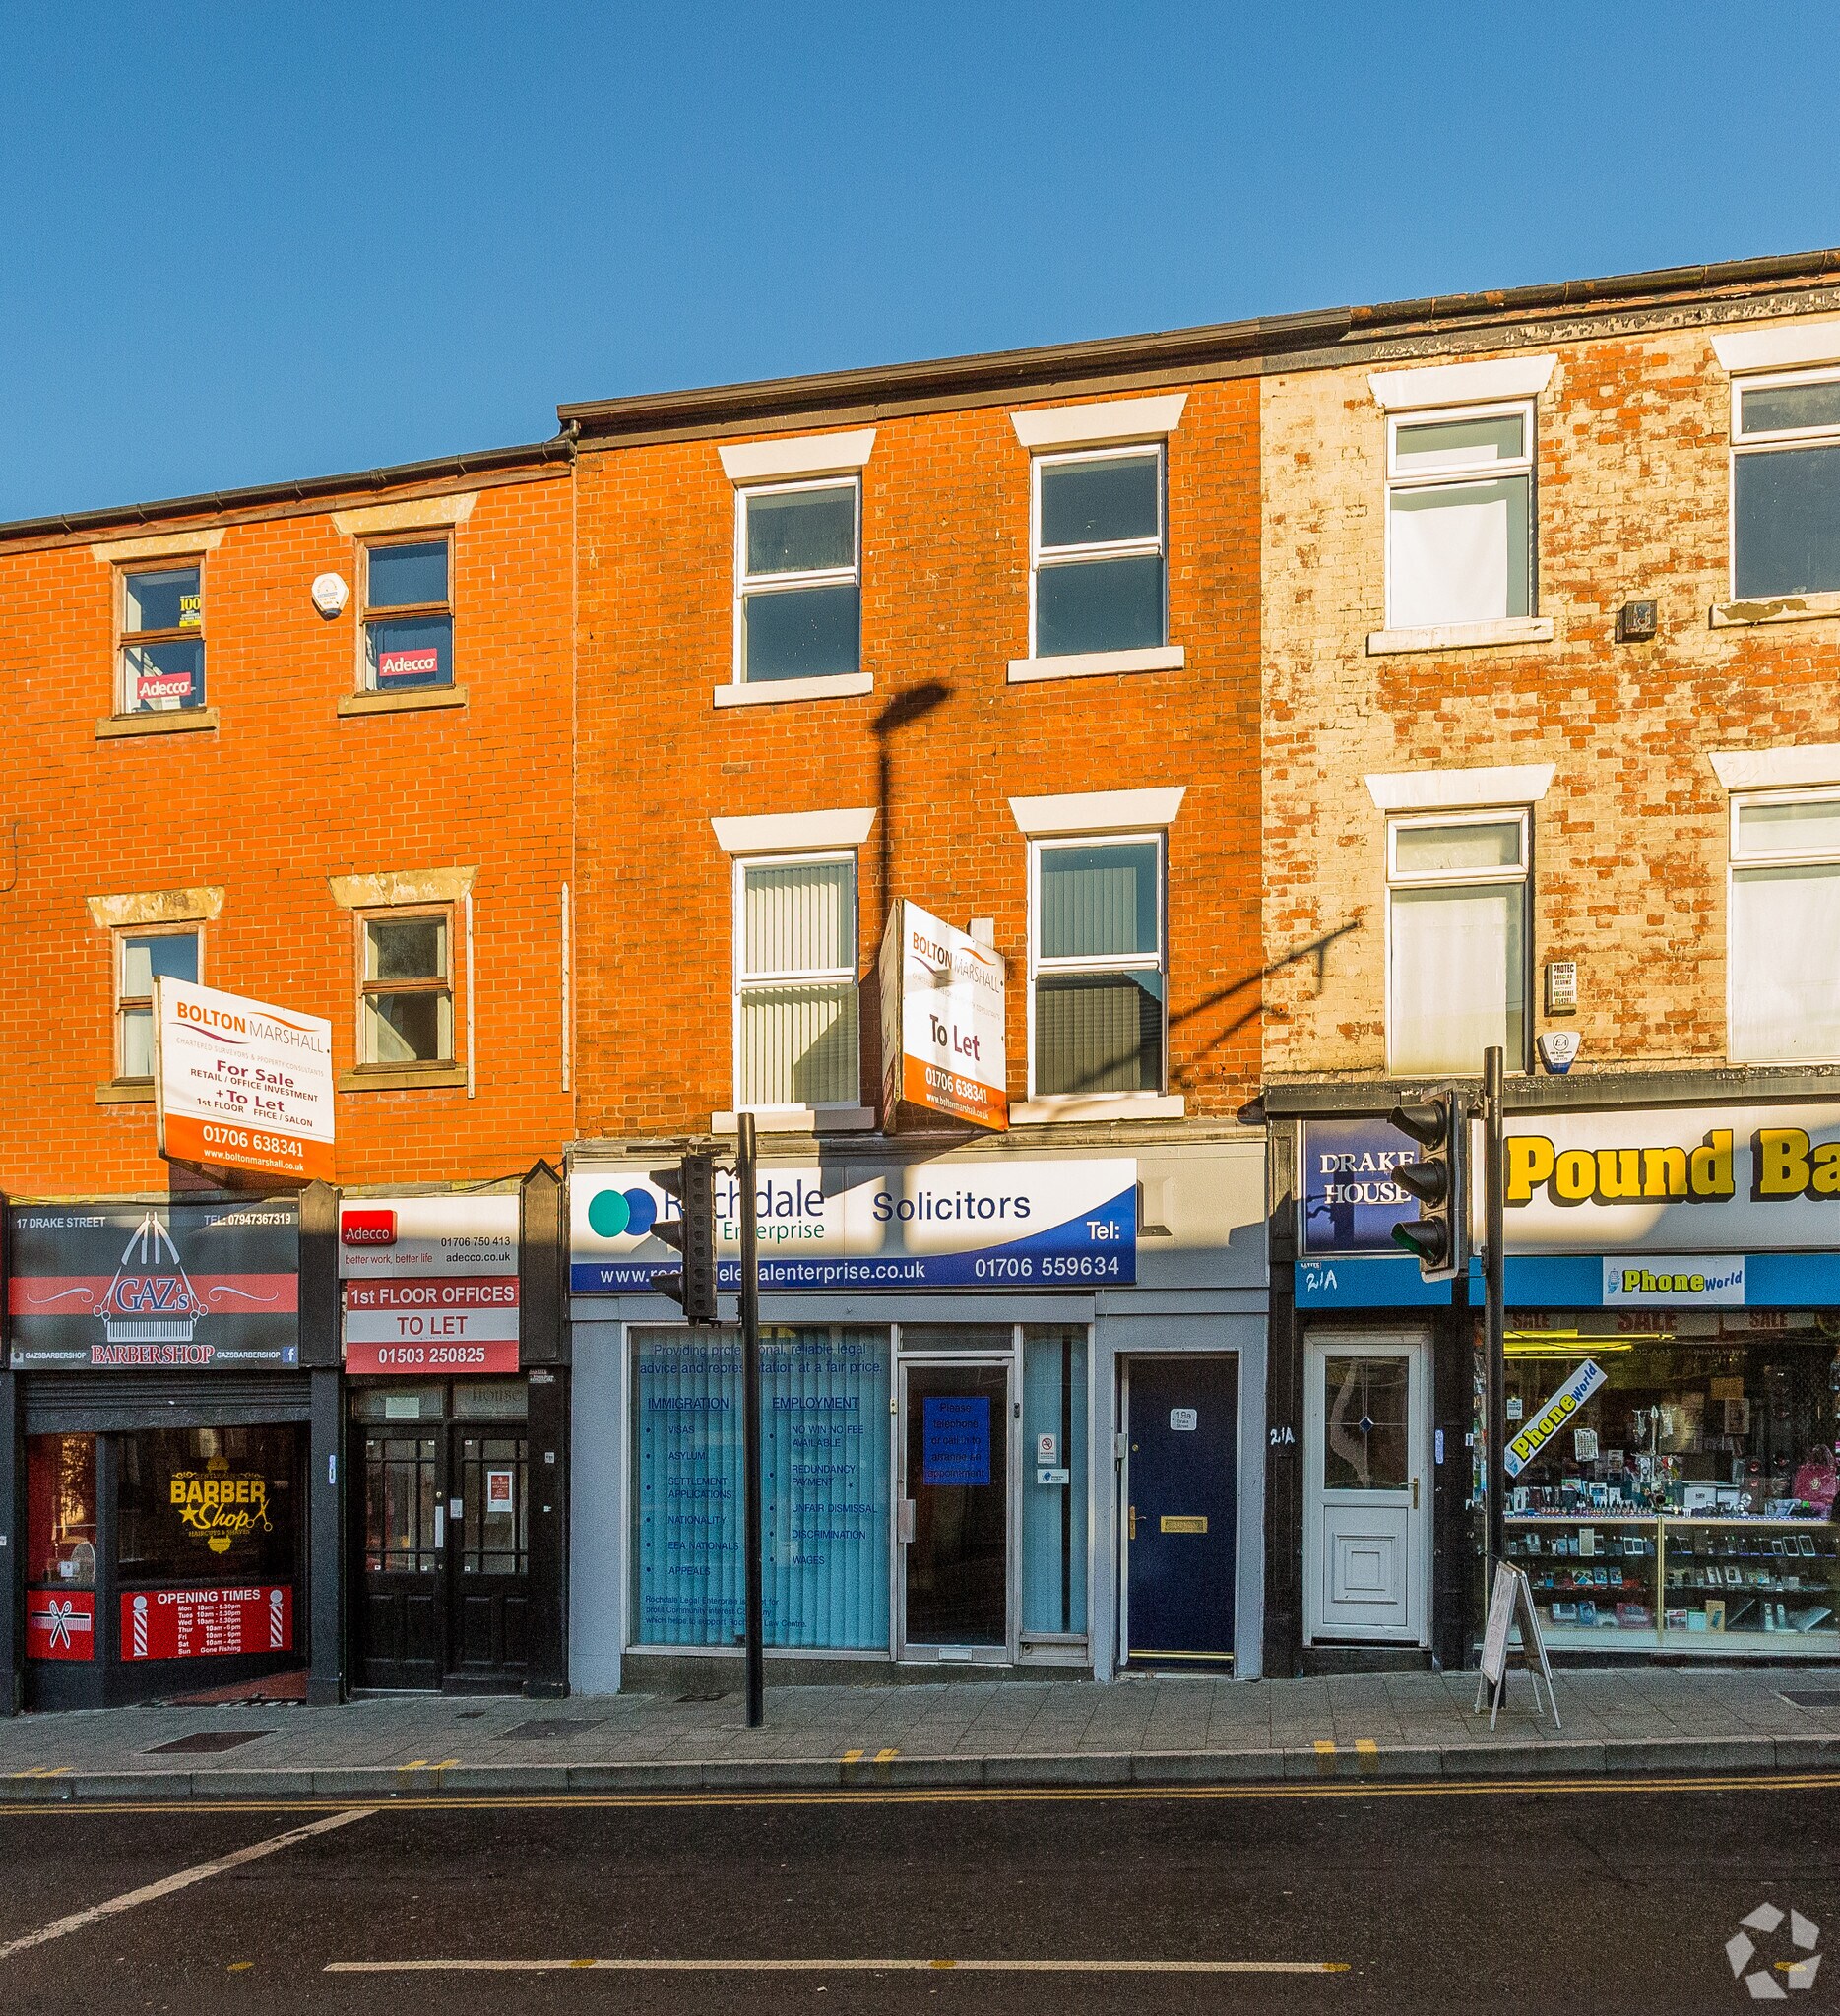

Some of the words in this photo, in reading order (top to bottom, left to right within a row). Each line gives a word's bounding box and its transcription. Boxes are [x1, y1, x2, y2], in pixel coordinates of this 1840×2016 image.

[180, 598, 201, 611] 100
[383, 657, 436, 673] Adecco
[140, 681, 189, 697] Adecco
[913, 932, 953, 969] BOLTON
[954, 955, 1000, 994] MARSHALL
[176, 1001, 246, 1034] BOLTON
[249, 1020, 323, 1053] MARSHALL
[929, 1014, 948, 1047] To
[953, 1024, 981, 1061] Let
[176, 1037, 213, 1051] CHARTERED
[215, 1045, 249, 1060] SURVEYORS
[257, 1054, 286, 1069] PROPERTY
[286, 1062, 324, 1077] CONSULTANTS
[217, 1059, 249, 1078] For
[256, 1068, 294, 1088] Sale
[190, 1068, 222, 1083] RETAIL
[230, 1077, 262, 1091] OFFICE
[264, 1084, 319, 1102] INVESTMENT
[925, 1067, 954, 1093] 01706
[955, 1079, 988, 1104] 638341
[226, 1089, 248, 1104] To
[256, 1095, 286, 1113] Let
[197, 1098, 211, 1108] 1st
[214, 1101, 244, 1114] FLOOR
[284, 1114, 313, 1128] SALON
[203, 1125, 248, 1148] 01706
[252, 1134, 303, 1158] 638341
[204, 1148, 304, 1171] www.boltonmarshall.co.uk
[1503, 1128, 1736, 1208] Pound
[665, 1179, 825, 1220] Rchdale
[872, 1190, 1031, 1222] Solicitors
[1324, 1182, 1412, 1205] HOUSE
[16, 1219, 28, 1228] 17
[30, 1218, 65, 1228] DRAKE
[67, 1217, 106, 1228] STREET
[204, 1215, 226, 1226] TEL:
[228, 1213, 291, 1225] 07947367319
[345, 1227, 390, 1240] Adecco
[723, 1221, 825, 1244] Enerprise
[1087, 1221, 1120, 1240] Tel:
[441, 1238, 471, 1247] 01706
[473, 1237, 490, 1246] 750
[492, 1236, 510, 1246] 413
[345, 1254, 370, 1265] better
[370, 1254, 393, 1264] work,
[395, 1253, 413, 1264] better
[415, 1252, 433, 1263] life
[445, 1252, 510, 1262] adecco.co.uk
[975, 1258, 1033, 1277] 01706
[1042, 1256, 1119, 1276] 559634
[1622, 1269, 1705, 1293] Phone
[115, 1278, 189, 1311] GAZ's
[350, 1289, 375, 1305] 1st
[379, 1288, 437, 1304] FLOOR
[442, 1286, 515, 1303] OFFICES
[397, 1316, 424, 1336] TO
[429, 1315, 469, 1335] LET
[26, 1352, 87, 1360] GAZSBARBERSHOP
[91, 1345, 215, 1364] BARBERSHOP
[217, 1351, 280, 1359] GAZSBARBERSHOP
[378, 1348, 425, 1364] 01503
[429, 1347, 485, 1364] 250825
[654, 1344, 707, 1358] Providing
[711, 1343, 787, 1358] profeonal,
[791, 1343, 833, 1354] reliable
[837, 1343, 866, 1356] legal
[640, 1362, 677, 1374] advice
[681, 1362, 705, 1374] and
[709, 1361, 794, 1376] represtation
[798, 1362, 811, 1374] at
[826, 1361, 845, 1373] fair
[849, 1362, 882, 1376] price.
[1571, 1363, 1598, 1402] World
[648, 1398, 729, 1410] IMMIGRATION
[772, 1397, 859, 1410] EMPLOYMENT
[939, 1402, 972, 1413] Please
[667, 1425, 695, 1435] VISAS
[792, 1425, 805, 1435] NO
[808, 1425, 827, 1435] WIN
[830, 1425, 844, 1435] NO
[847, 1425, 864, 1435] FEE
[933, 1419, 979, 1429] telephone
[1511, 1393, 1577, 1463] Phone
[792, 1439, 841, 1448] AVAILABLE
[943, 1435, 959, 1445] call
[973, 1436, 981, 1445] to
[668, 1451, 707, 1461] ASYLUM
[792, 1465, 856, 1474] REDUNDANCY
[667, 1477, 728, 1486] SETTLEMENT
[792, 1478, 835, 1486] PAYMENT
[170, 1480, 266, 1504] BARBER
[668, 1489, 732, 1499] APPLICATIONS
[193, 1500, 249, 1531] Shop
[792, 1504, 825, 1514] UNFAIR
[828, 1504, 878, 1514] DISMISSAL
[667, 1516, 727, 1526] NATIONALITY
[792, 1530, 866, 1540] DISCRIMINATION
[667, 1542, 685, 1551] EEA
[689, 1542, 739, 1551] NATIONALS
[793, 1555, 825, 1565] WAGES
[668, 1566, 711, 1576] APPEALS
[158, 1591, 219, 1605] OPENING
[221, 1589, 261, 1602] TIMES
